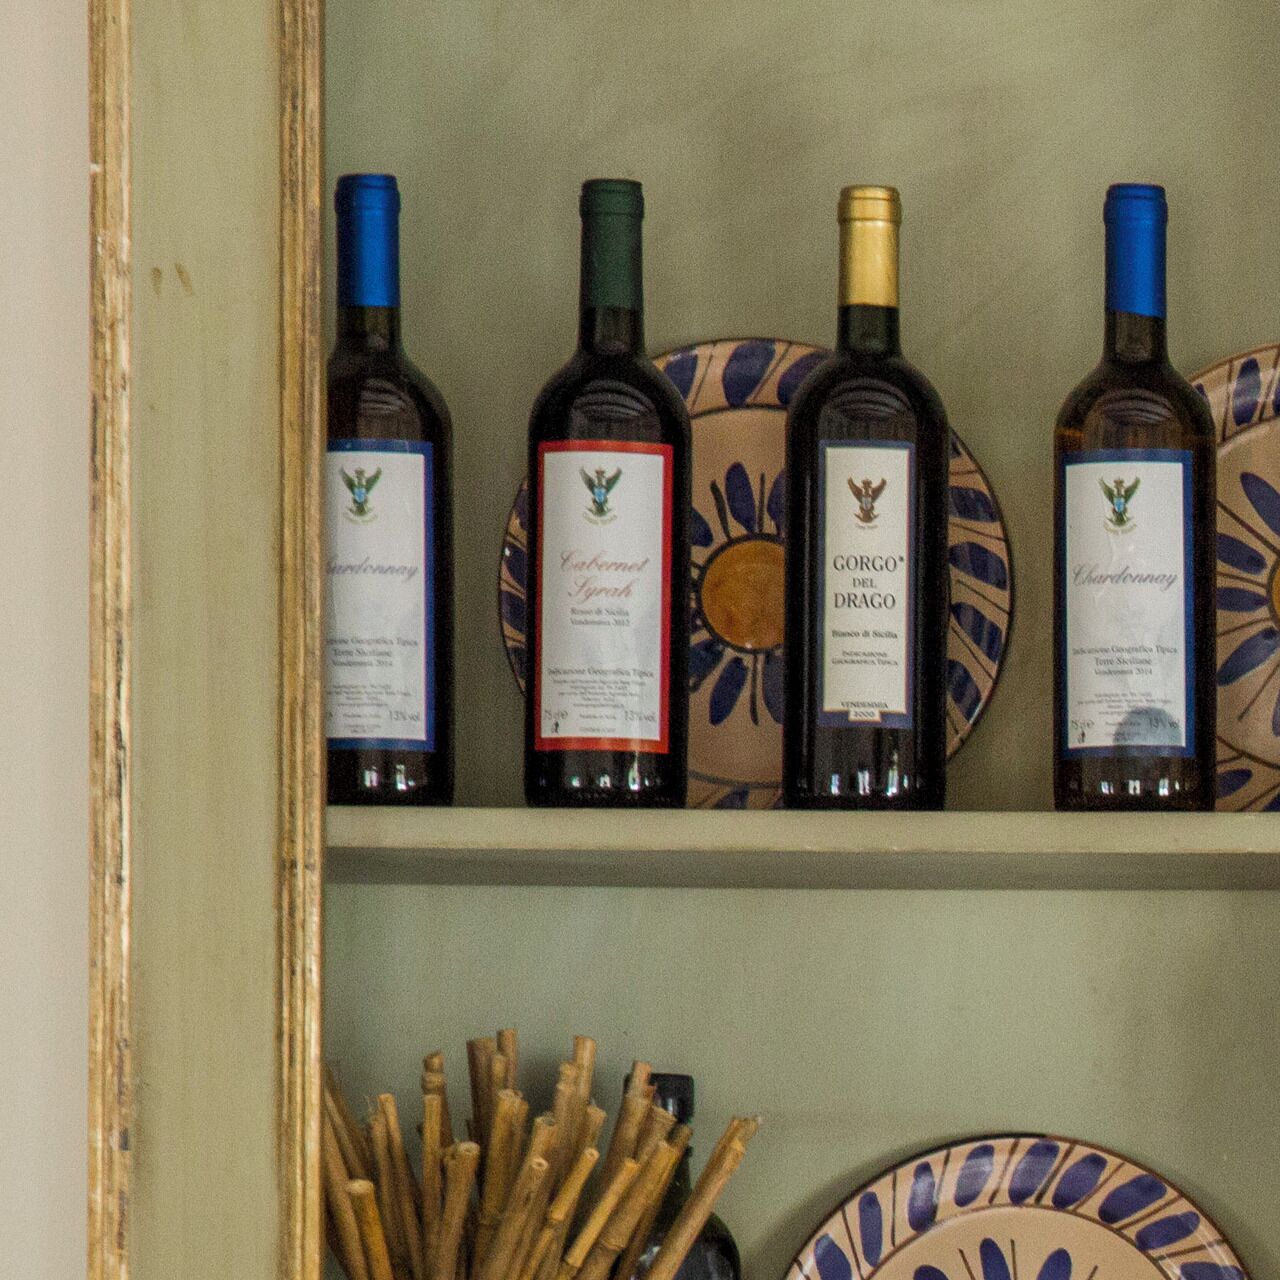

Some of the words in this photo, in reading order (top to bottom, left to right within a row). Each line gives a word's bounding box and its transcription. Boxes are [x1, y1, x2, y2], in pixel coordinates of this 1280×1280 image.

[560, 552, 649, 573] Cabernet
[833, 555, 897, 572] GORGO
[852, 577, 877, 589] DEL
[1071, 565, 1179, 591] Chardonnay
[568, 576, 638, 601] Syrah
[834, 592, 896, 609] DRAGO
[605, 607, 629, 616] Sicilia
[832, 630, 860, 639] Bianco
[861, 630, 870, 638] di
[872, 630, 898, 639] Sicilia
[841, 701, 888, 709] VENDEMMIA
